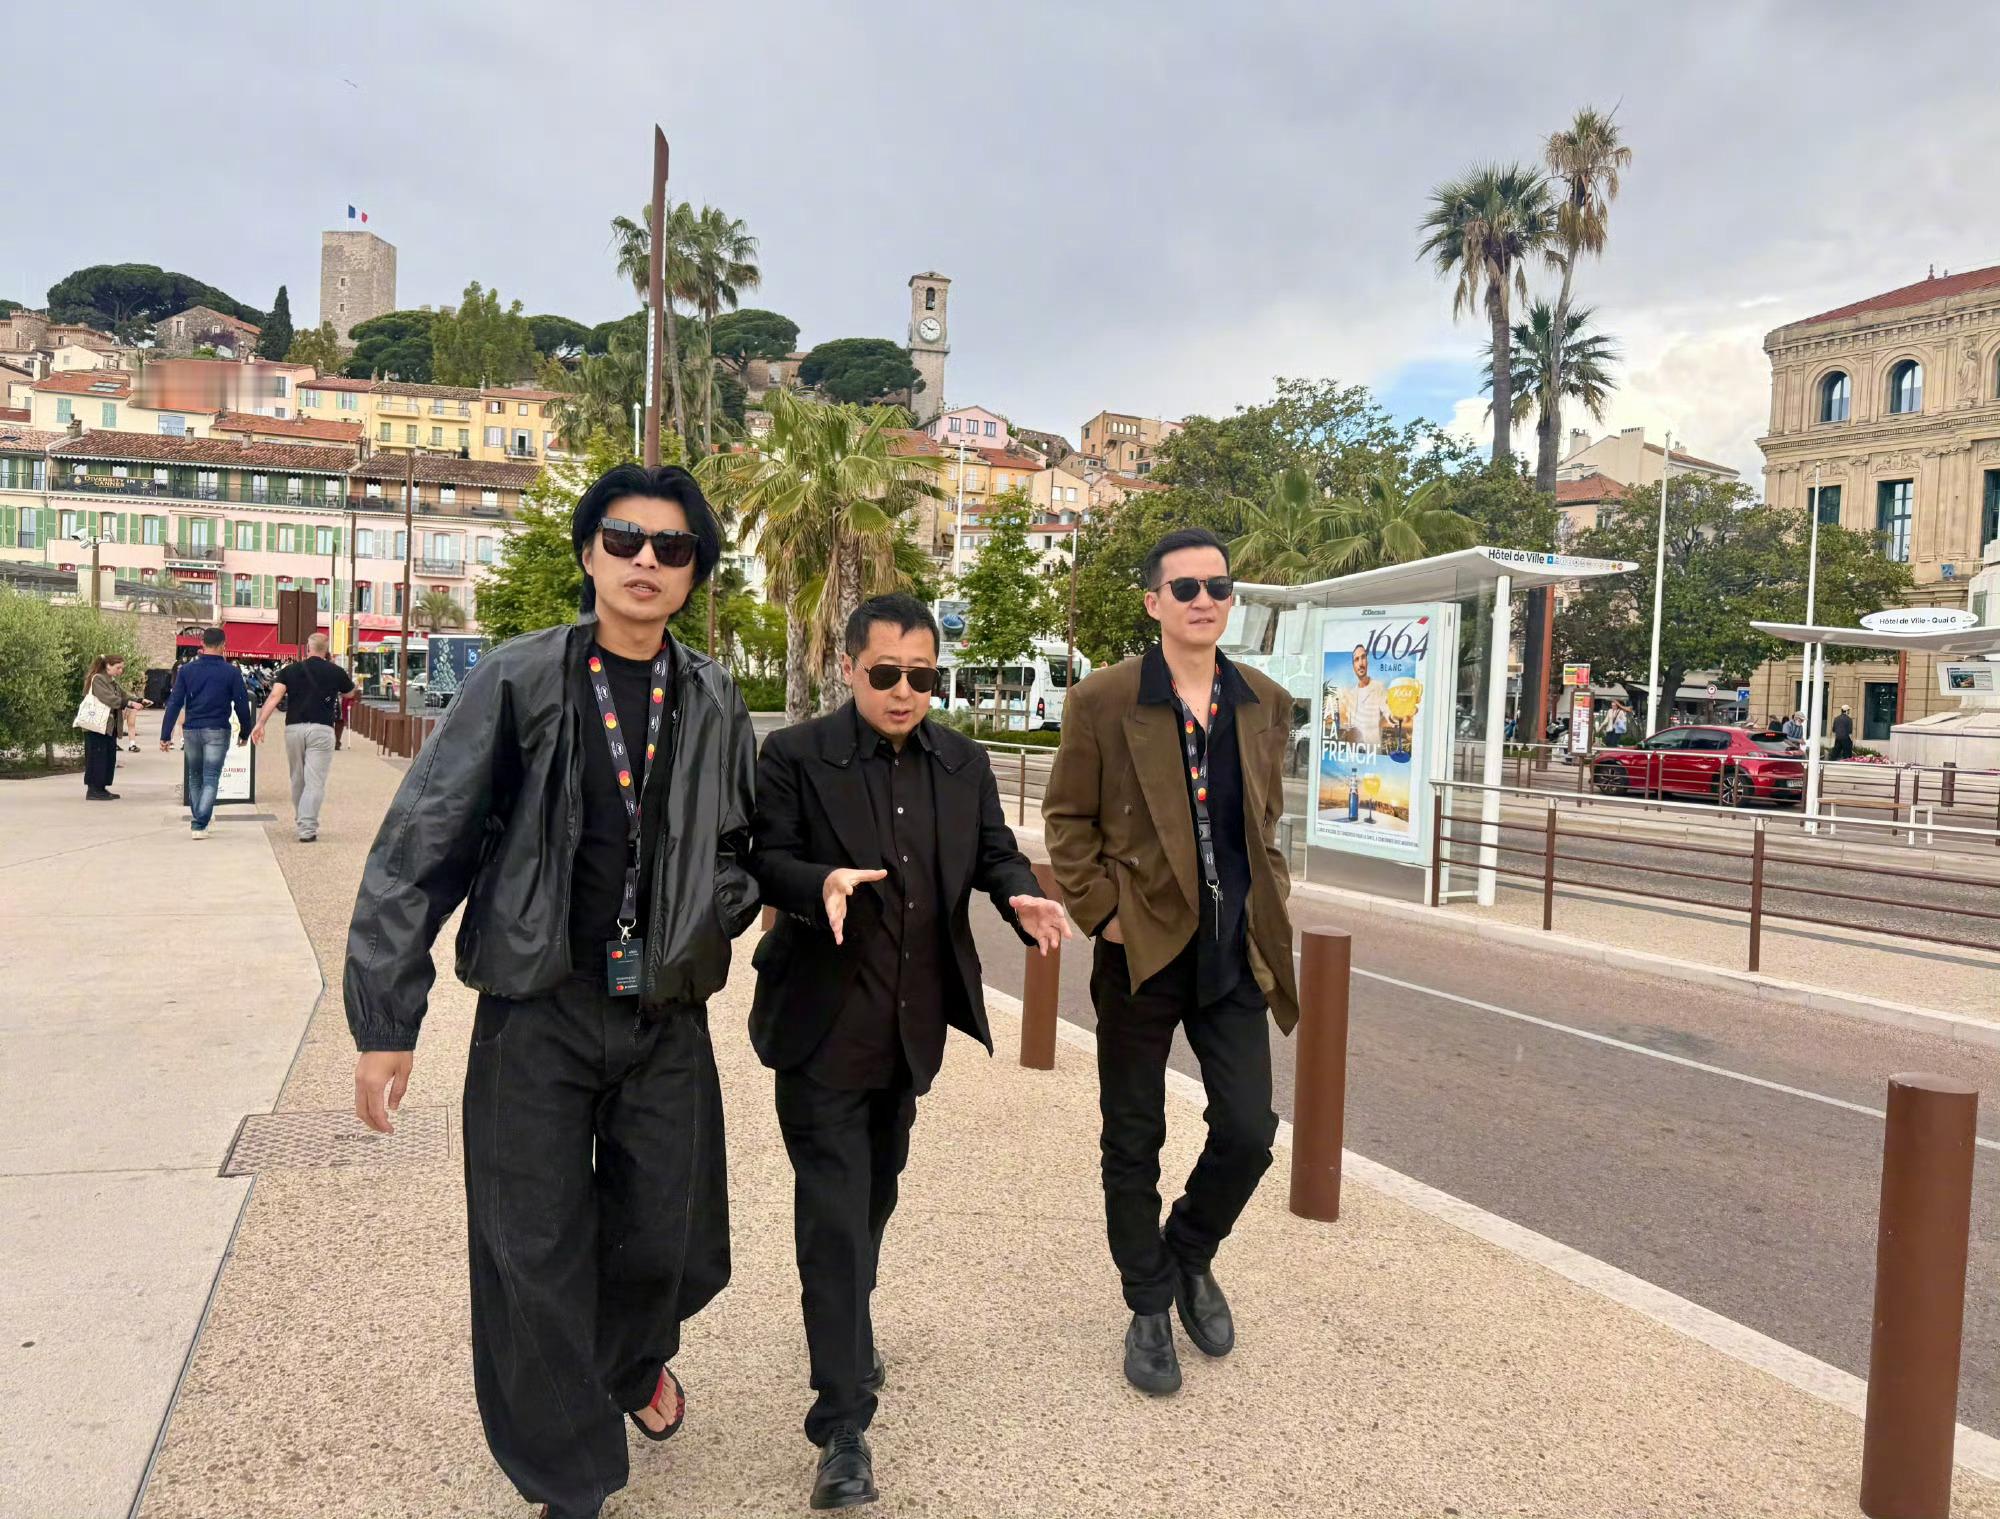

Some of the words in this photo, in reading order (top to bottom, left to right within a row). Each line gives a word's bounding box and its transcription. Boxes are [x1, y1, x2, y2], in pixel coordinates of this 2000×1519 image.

[1488, 549, 1512, 561] Hôtel
[1513, 551, 1525, 562] de
[1526, 552, 1545, 564] Ville
[1879, 617, 1899, 625] Hôtel
[1931, 616, 1949, 624] Quai
[1366, 622, 1430, 661] 1664
[1380, 663, 1402, 672] BLANC
[1322, 720, 1338, 740] LA
